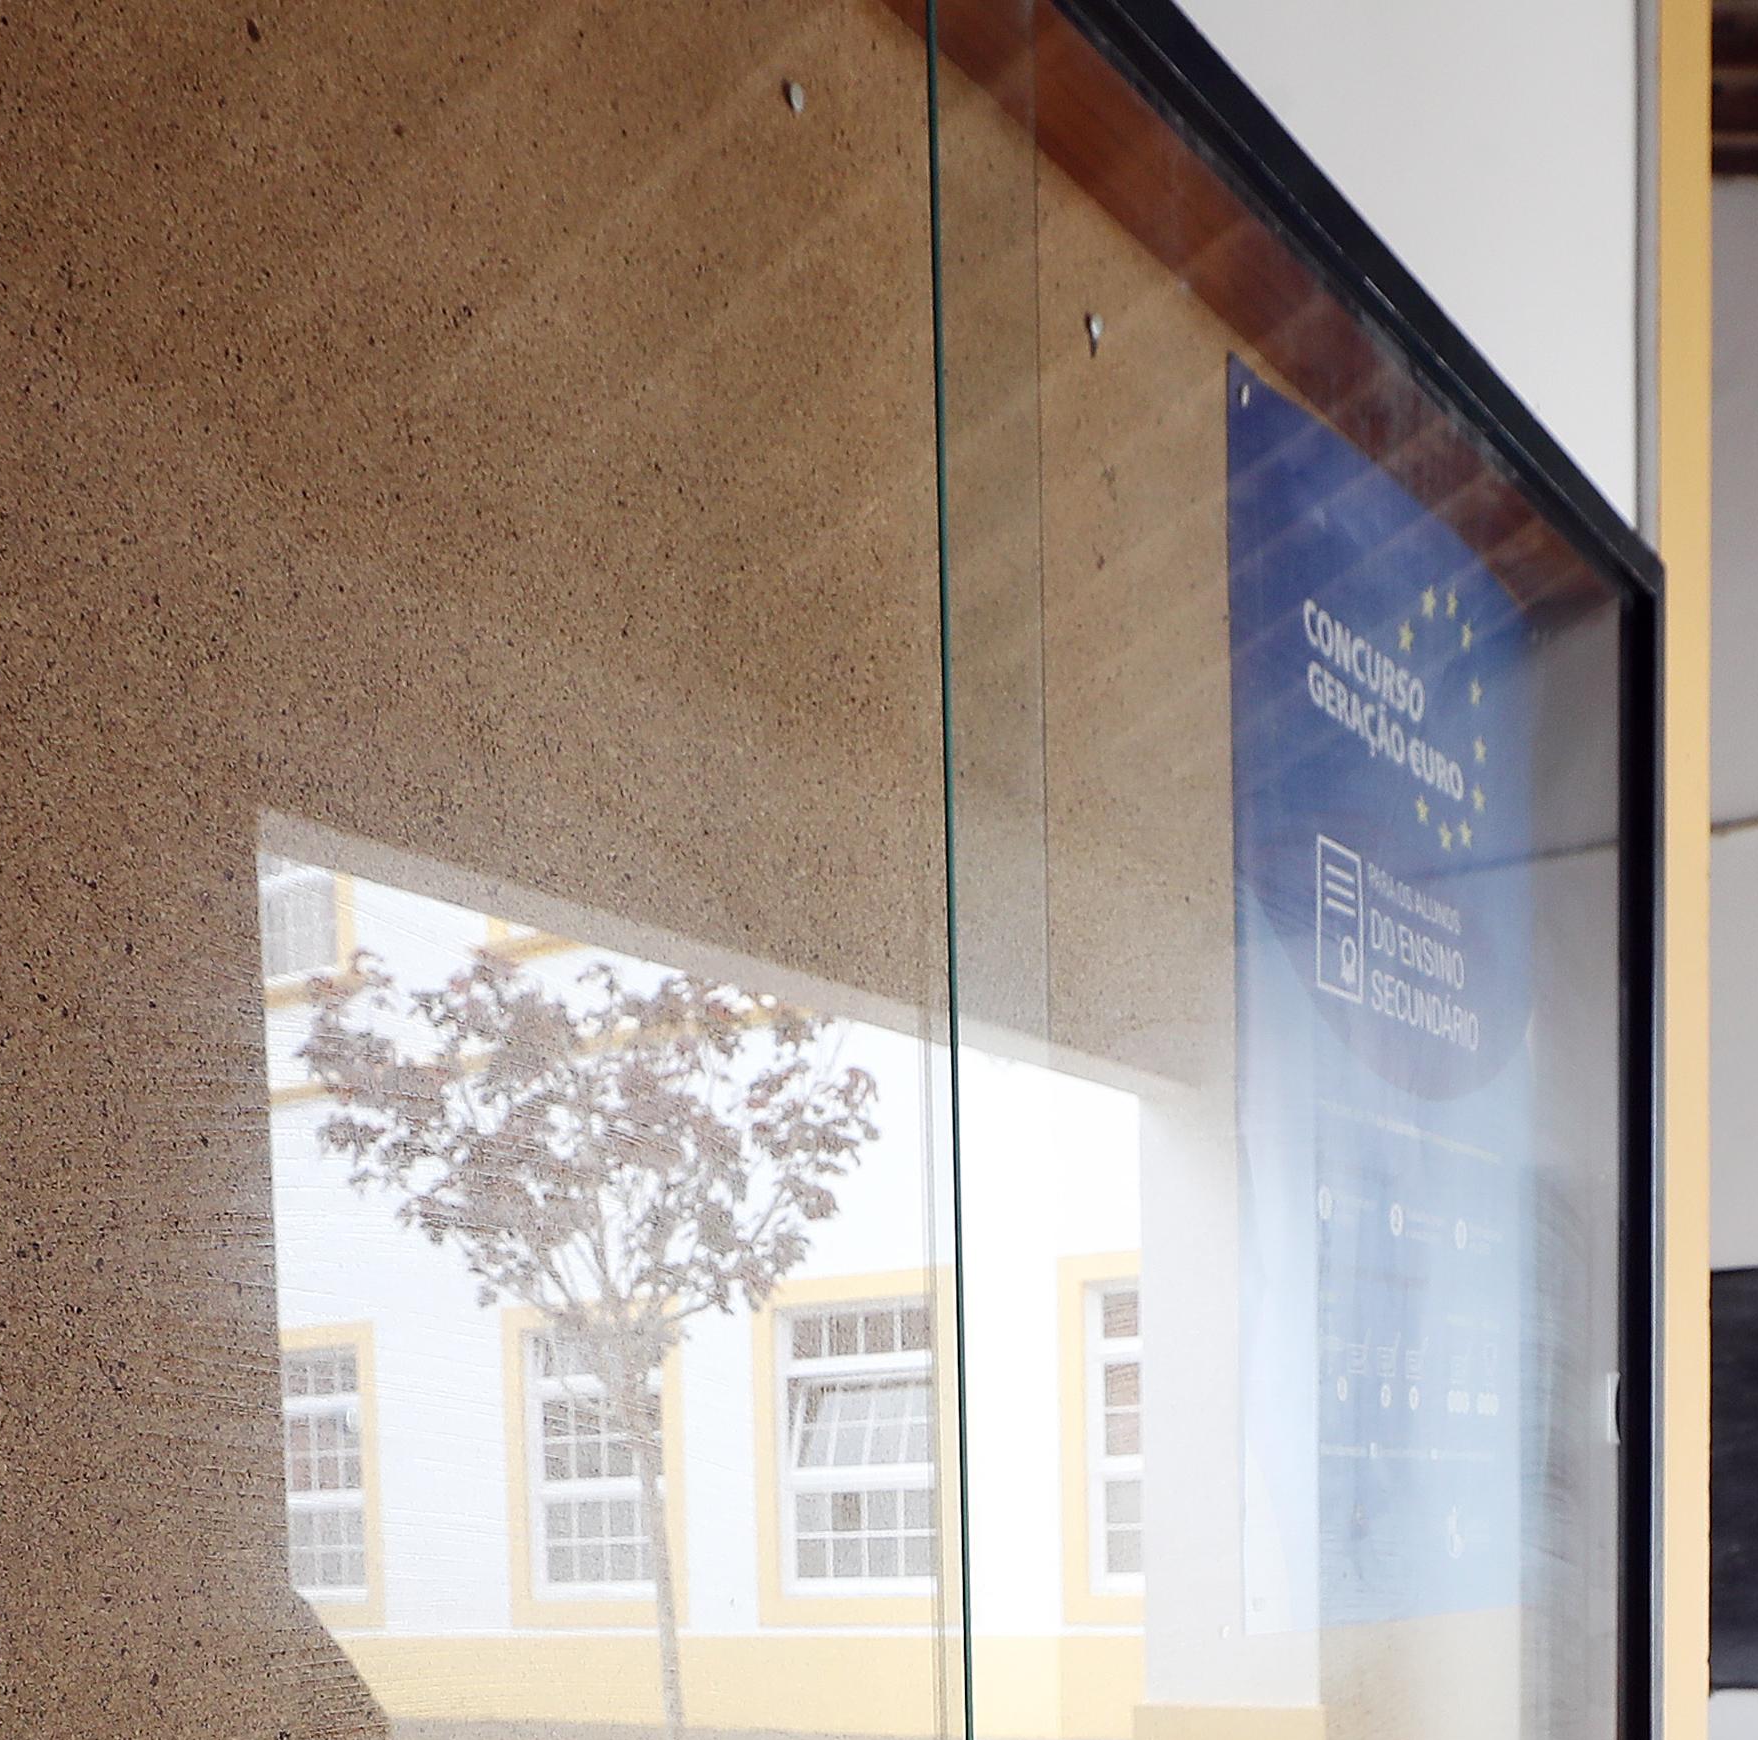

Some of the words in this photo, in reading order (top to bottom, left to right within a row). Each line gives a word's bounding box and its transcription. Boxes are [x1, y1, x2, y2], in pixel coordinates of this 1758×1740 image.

[1303, 597, 1425, 722] CONCURSO
[1307, 661, 1406, 765] GERAÇÃO
[1369, 907, 1396, 957] DO
[1398, 924, 1465, 990] ENSINO
[1371, 969, 1479, 1051] SECUNDÁRIO
